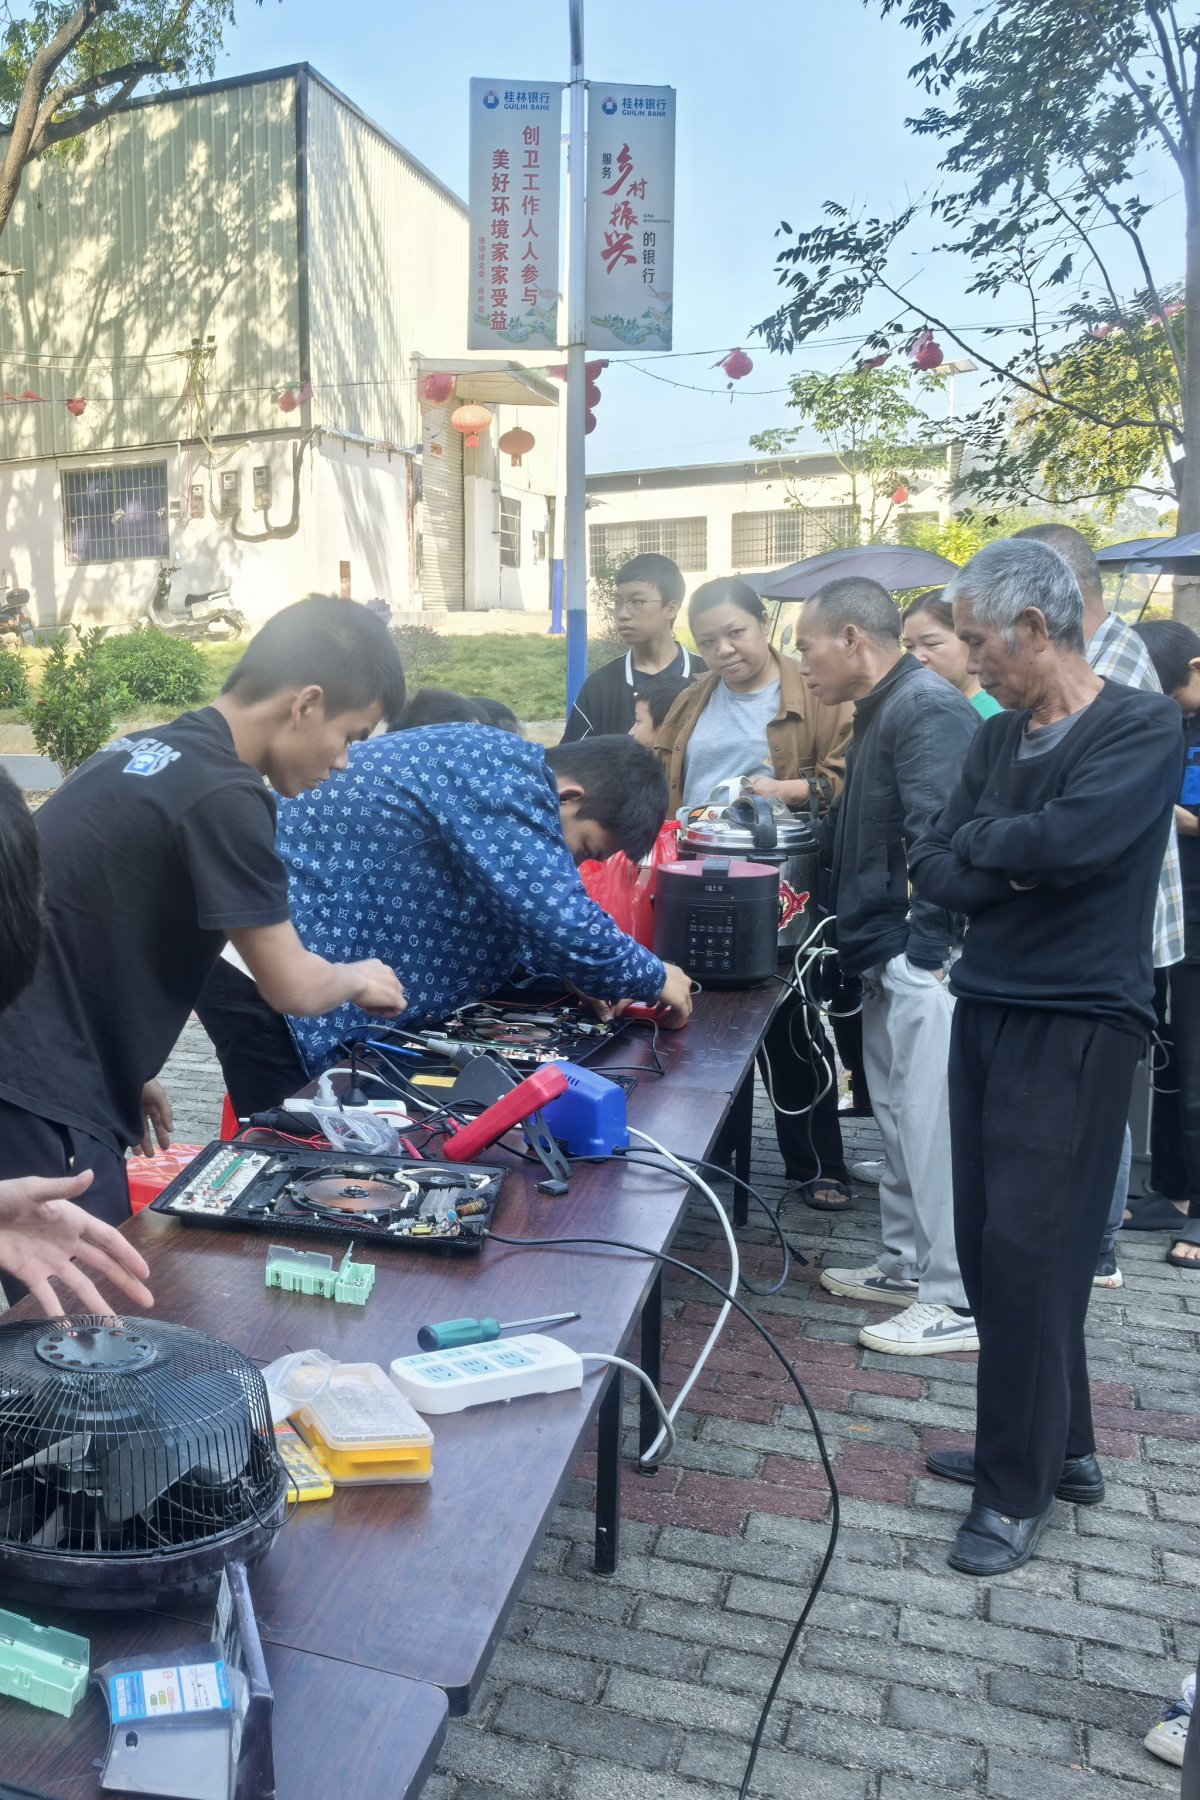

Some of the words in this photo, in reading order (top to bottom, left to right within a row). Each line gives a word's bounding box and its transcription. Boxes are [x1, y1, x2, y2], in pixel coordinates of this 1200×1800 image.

[503, 90, 550, 103] 桂林银行
[622, 97, 667, 110] 桂林银行
[602, 153, 612, 179] 服务
[521, 125, 540, 306] 创卫工作人人参与
[490, 148, 510, 331] 美好环境家家受益
[642, 231, 656, 284] 的银行
